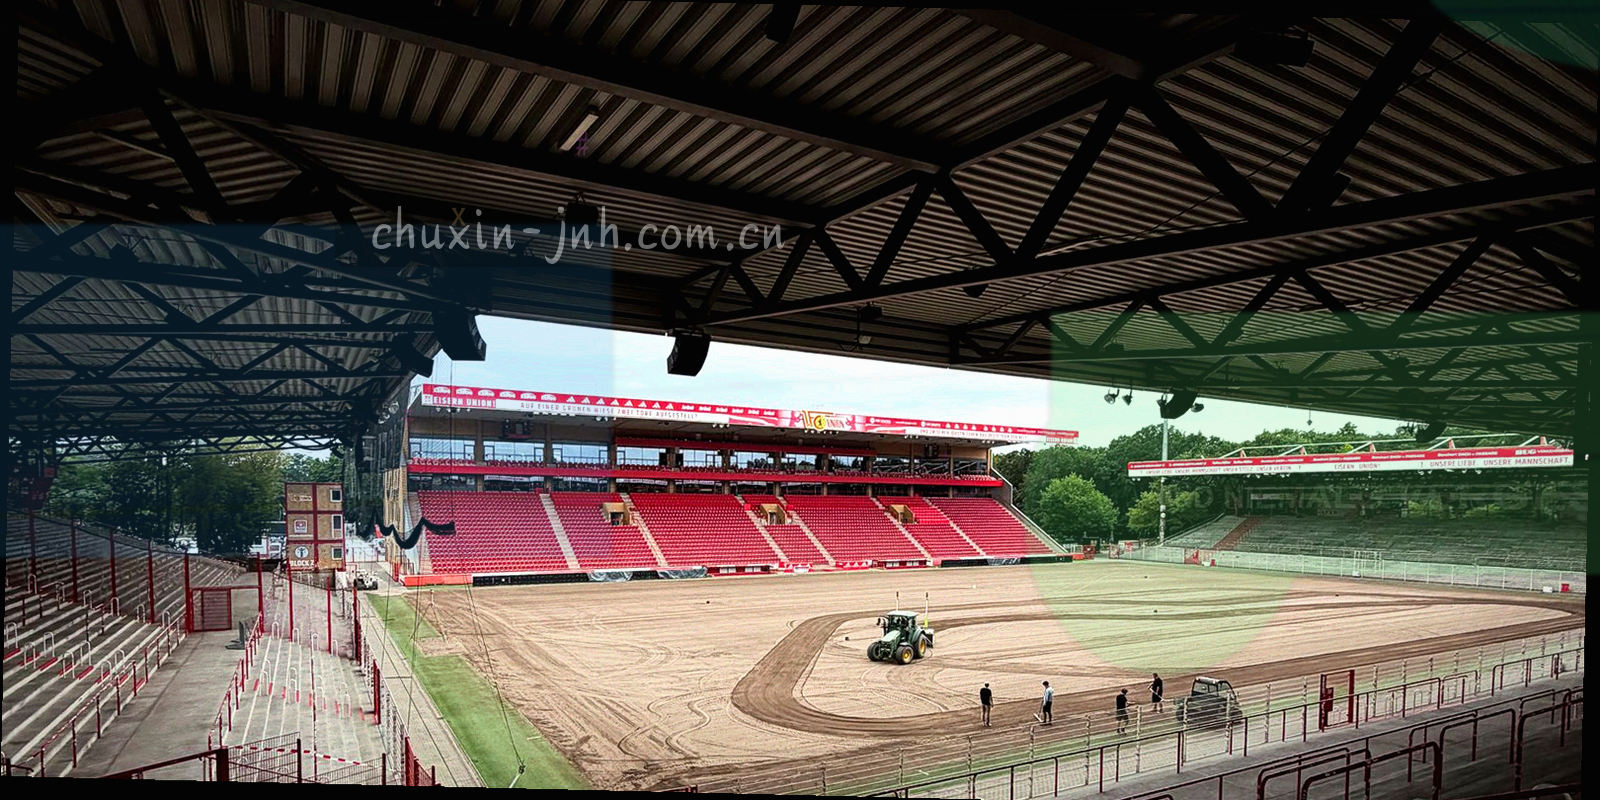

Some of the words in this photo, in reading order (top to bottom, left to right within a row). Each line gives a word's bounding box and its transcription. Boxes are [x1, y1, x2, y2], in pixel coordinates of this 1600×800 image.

[433, 396, 463, 406] EISERN
[466, 398, 496, 409] UNION!
[1484, 458, 1511, 466] UNSERE
